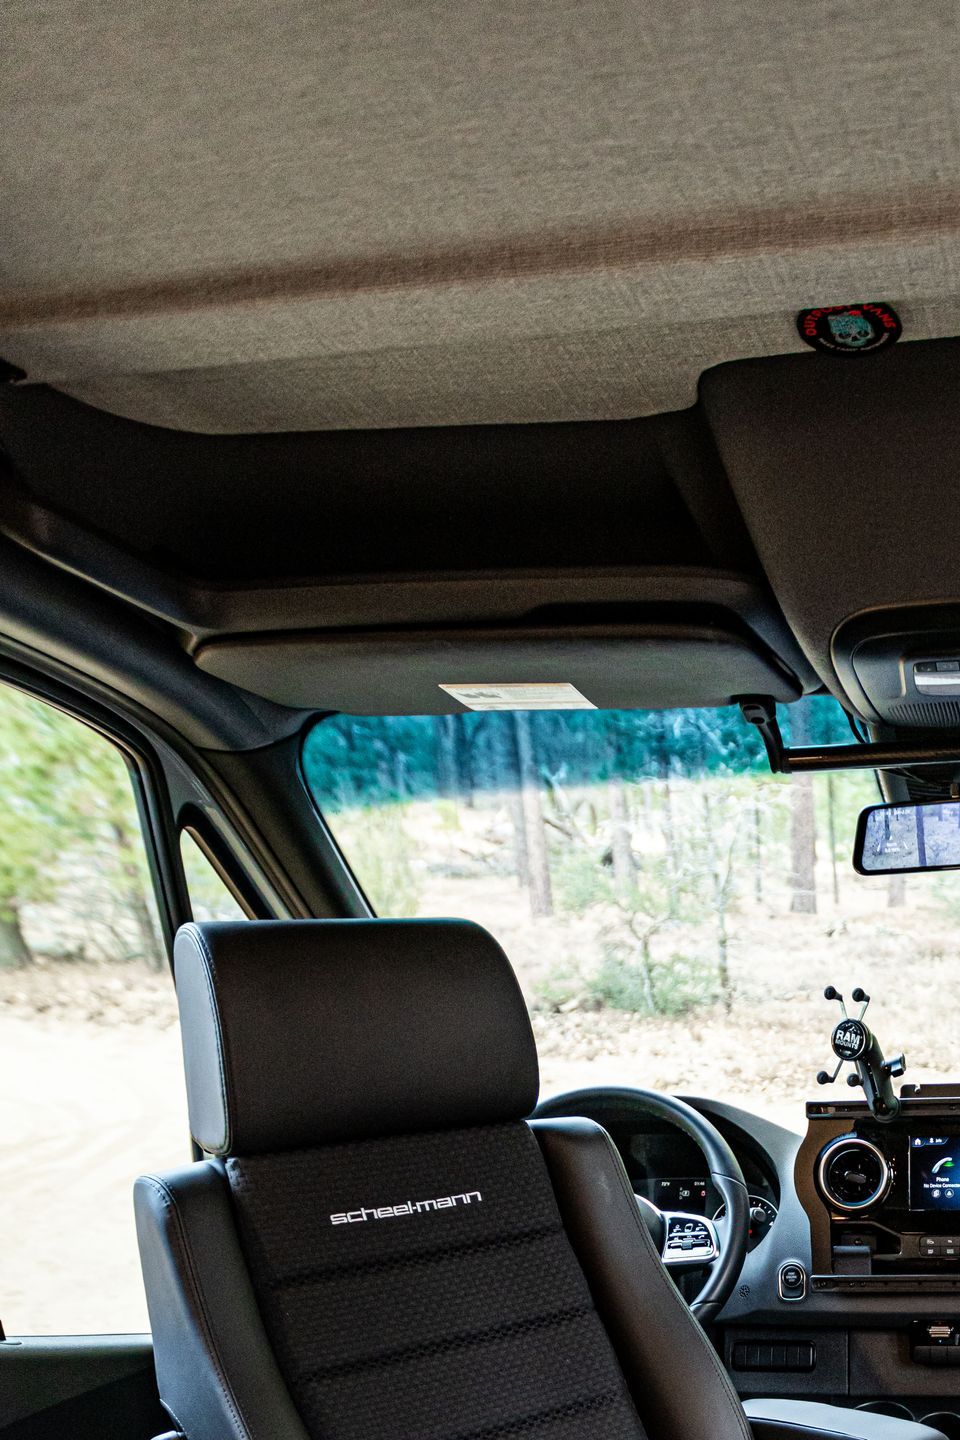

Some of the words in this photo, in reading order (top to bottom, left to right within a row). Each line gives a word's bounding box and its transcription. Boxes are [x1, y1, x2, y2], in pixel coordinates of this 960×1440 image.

[835, 1039, 858, 1050] MOUNTS
[836, 1029, 860, 1045] RAM
[330, 1191, 483, 1225] scheel-mann
